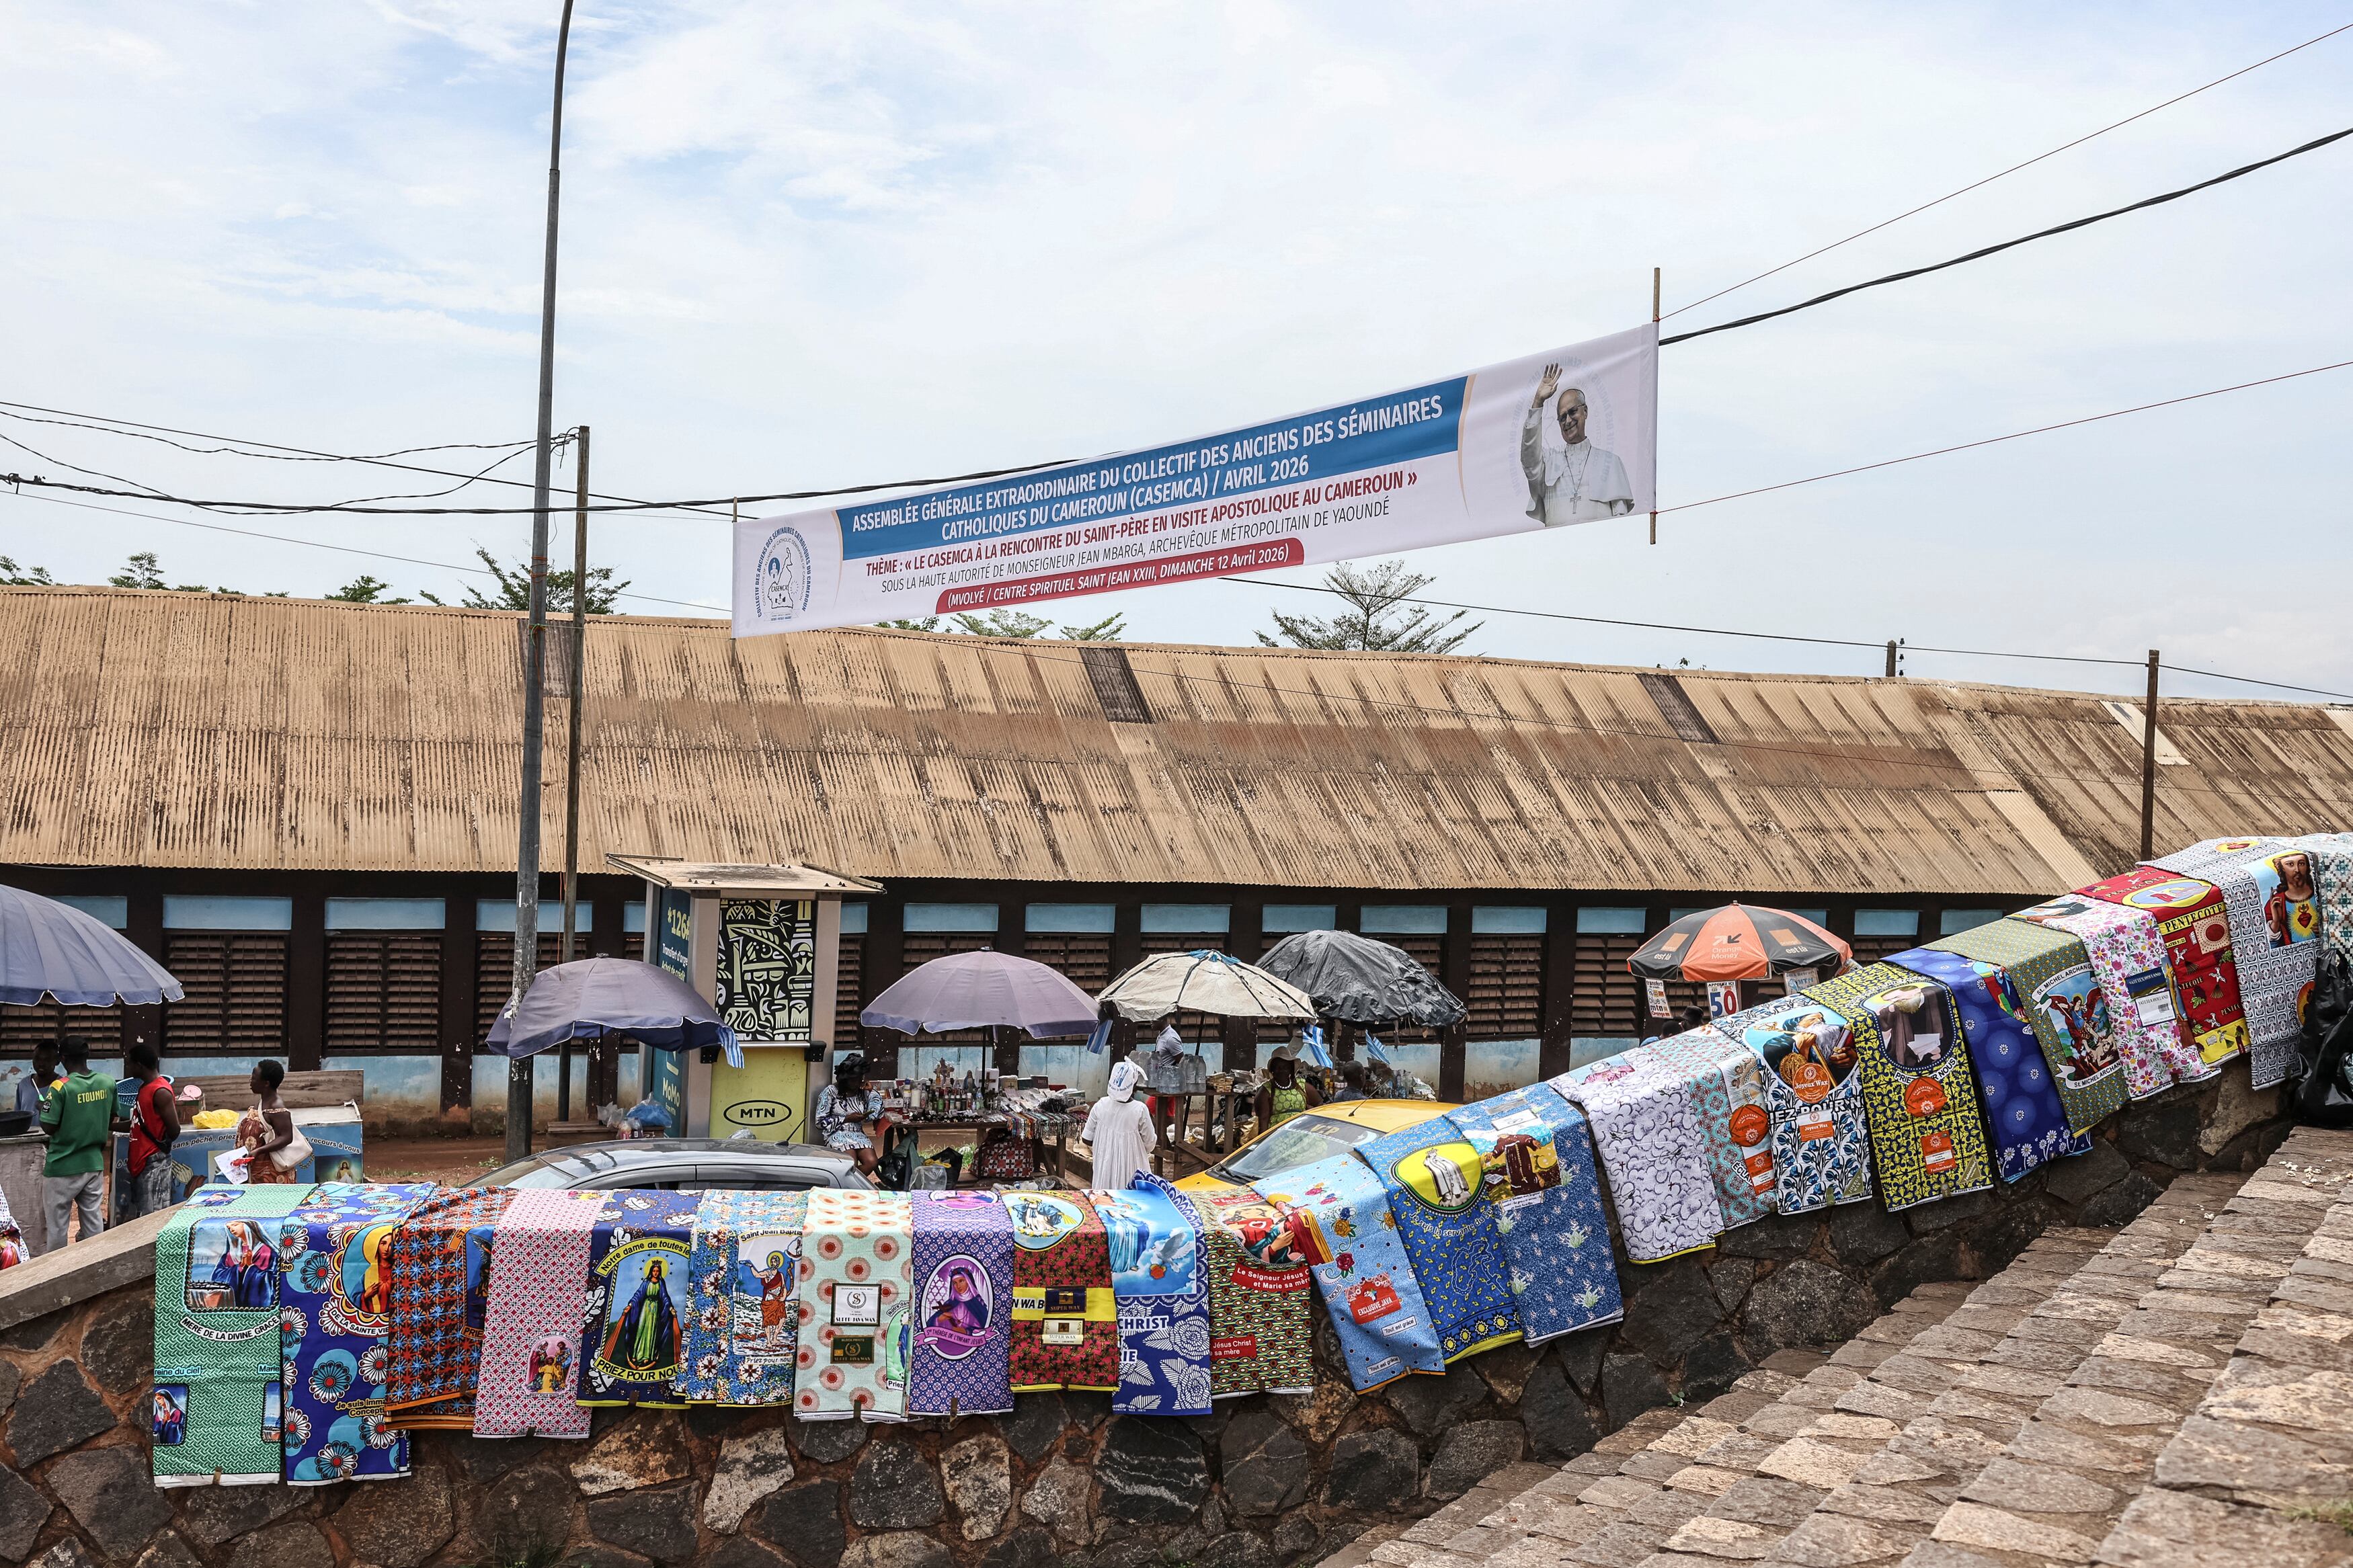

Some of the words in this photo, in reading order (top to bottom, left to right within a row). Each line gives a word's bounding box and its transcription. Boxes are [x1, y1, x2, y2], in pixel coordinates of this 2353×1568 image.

[852, 501, 918, 532] ASSEMBLÉE
[922, 493, 982, 521] GÉNÉRALE
[986, 476, 1096, 509] EXTRAORDINAIRE
[1100, 468, 1119, 489] DU
[1123, 451, 1197, 483] COLLECTIF
[1200, 444, 1228, 468] DES
[1232, 428, 1298, 462] ANCIENS
[1303, 420, 1334, 448] DES
[1338, 395, 1443, 440] SÉMINAIRES
[941, 509, 1027, 541] CATHOLIQUES
[1029, 505, 1048, 526] DU
[1051, 497, 1127, 523] CAMEROUN
[1130, 471, 1209, 511] (CASEMCA)
[1211, 470, 1220, 495] /
[1224, 463, 1266, 491] AVRIL
[1271, 454, 1309, 481] 2026
[866, 559, 898, 577] THÈME
[914, 556, 925, 570] LE
[927, 548, 973, 569] CASEMCA
[975, 542, 982, 562] À
[984, 544, 998, 559] LA
[1000, 533, 1063, 558] RENCONTRE
[1066, 530, 1081, 546] DU
[1083, 516, 1149, 544] SAINT-PÈRE
[1152, 515, 1167, 532] EN
[1170, 507, 1208, 529] VISITE
[1210, 491, 1300, 523] APOSTOLIQUE
[1302, 486, 1320, 506] AU
[1324, 470, 1403, 503] CAMEROUN
[881, 579, 905, 593] SOUS
[906, 576, 916, 590] LA
[918, 571, 945, 588] HAUTE
[948, 563, 990, 584] AUTORITÉ
[993, 564, 1004, 577] DE
[1006, 552, 1075, 576] MONSEIGNEUR
[1076, 549, 1100, 568] JEAN
[1103, 543, 1146, 562] MBARGA,
[1148, 530, 1218, 559] ARCHEVÊQUE
[1220, 513, 1310, 542] MÉTROPOLITAIN
[1314, 510, 1328, 527] DE
[1332, 495, 1389, 524] YAOUNDÉ
[947, 587, 984, 609] (MVOLYÉ
[986, 587, 992, 604] /
[993, 584, 1027, 601] CENTRE
[1029, 579, 1074, 598] SPIRITUEL
[1077, 573, 1105, 590] SAINT
[1106, 570, 1130, 588] JEAN
[1132, 565, 1157, 582] XXIII,
[1160, 555, 1214, 577] DIMANCHE
[1217, 555, 1228, 569] 12
[1230, 550, 1255, 567] Avril
[1257, 543, 1289, 563] 2026)
[663, 943, 677, 960] Transfert
[1711, 952, 1739, 960] Money
[1712, 946, 1741, 954] Orange
[2044, 975, 2065, 989] MICHEL
[2065, 963, 2091, 977] ARCHANG
[1710, 990, 1737, 1016] 50
[2153, 995, 2169, 1003] HOLLAND
[1937, 1058, 1956, 1078] NOUS
[2081, 1075, 2100, 1085] MICHEL
[2100, 1063, 2121, 1077] ARCHAN
[663, 1077, 680, 1108] MoMo
[1794, 1081, 1814, 1090] Joyeux
[77, 1089, 107, 1104] ETOUNDI
[740, 1108, 775, 1118] MTN
[171, 1141, 189, 1150] sans
[190, 1136, 213, 1146] péché
[218, 1134, 237, 1143] priez
[310, 1137, 336, 1149] recours
[344, 1144, 360, 1154] vous
[1409, 1212, 1419, 1222] Je
[1419, 1221, 1434, 1232] suis
[1434, 1227, 1442, 1235] la
[1443, 1223, 1475, 1237] servante
[1474, 1217, 1484, 1227] du
[740, 1231, 759, 1241] Saint
[601, 1252, 621, 1272] Notre
[623, 1243, 645, 1255] dame
[659, 1240, 684, 1251] toutes
[1237, 1267, 1246, 1276] Le
[1247, 1270, 1280, 1281] Seigneur
[1282, 1272, 1303, 1281] Jésus
[1262, 1282, 1282, 1290] Marie
[1328, 1285, 1342, 1300] NOUS
[887, 1304, 900, 1315] Notre
[1021, 1298, 1035, 1309] WA
[1357, 1301, 1382, 1316] EXCLUSIVE
[1381, 1296, 1393, 1307] JAVA
[182, 1318, 202, 1335] MERE
[228, 1330, 253, 1340] DIVINE
[254, 1317, 279, 1335] GRACE
[331, 1309, 340, 1321] DE
[339, 1317, 348, 1327] LA
[350, 1323, 376, 1334] SAINTE
[175, 1366, 184, 1375] du
[186, 1366, 200, 1374] ciel
[596, 1360, 626, 1377] PRIEZ
[627, 1371, 655, 1381] POUR
[888, 1380, 904, 1389] Priez
[336, 1401, 346, 1410] Je
[347, 1400, 364, 1408] suis
